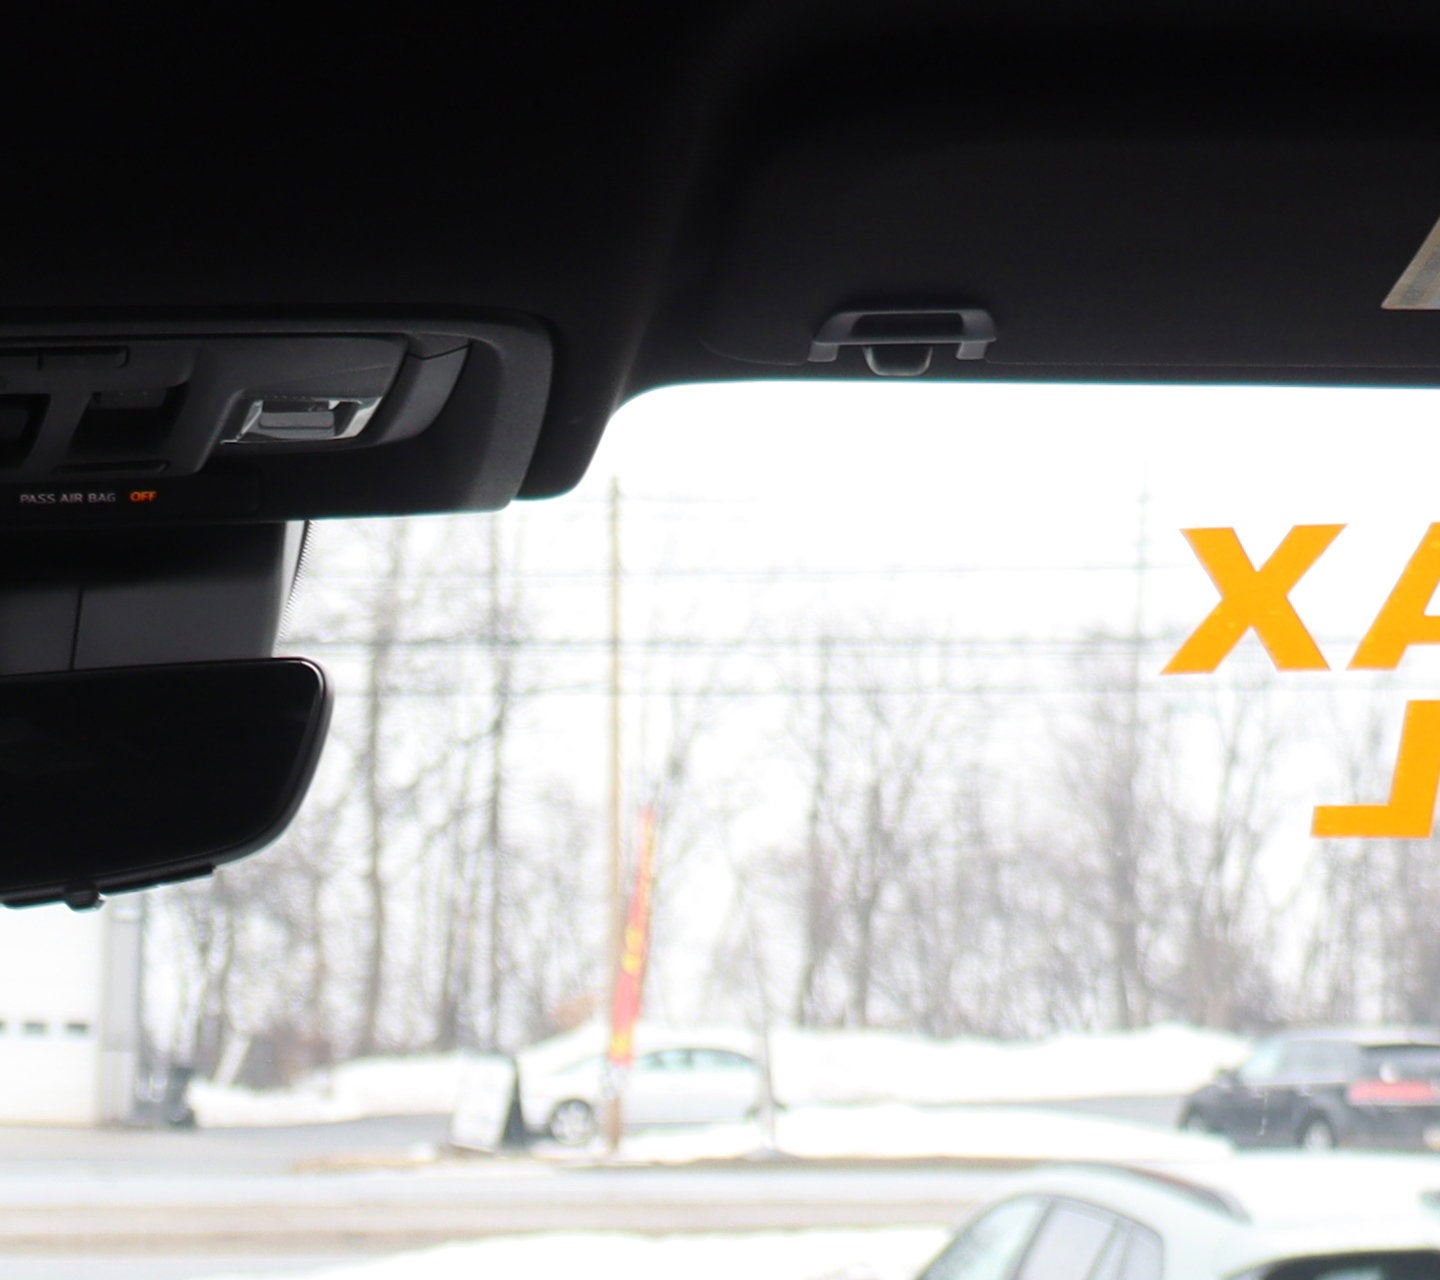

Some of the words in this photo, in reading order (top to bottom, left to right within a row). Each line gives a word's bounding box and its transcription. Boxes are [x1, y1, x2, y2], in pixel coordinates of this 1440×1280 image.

[19, 491, 56, 505] PASS
[60, 491, 84, 504] AIR
[87, 490, 117, 504] BAG
[127, 489, 159, 504] OFF
